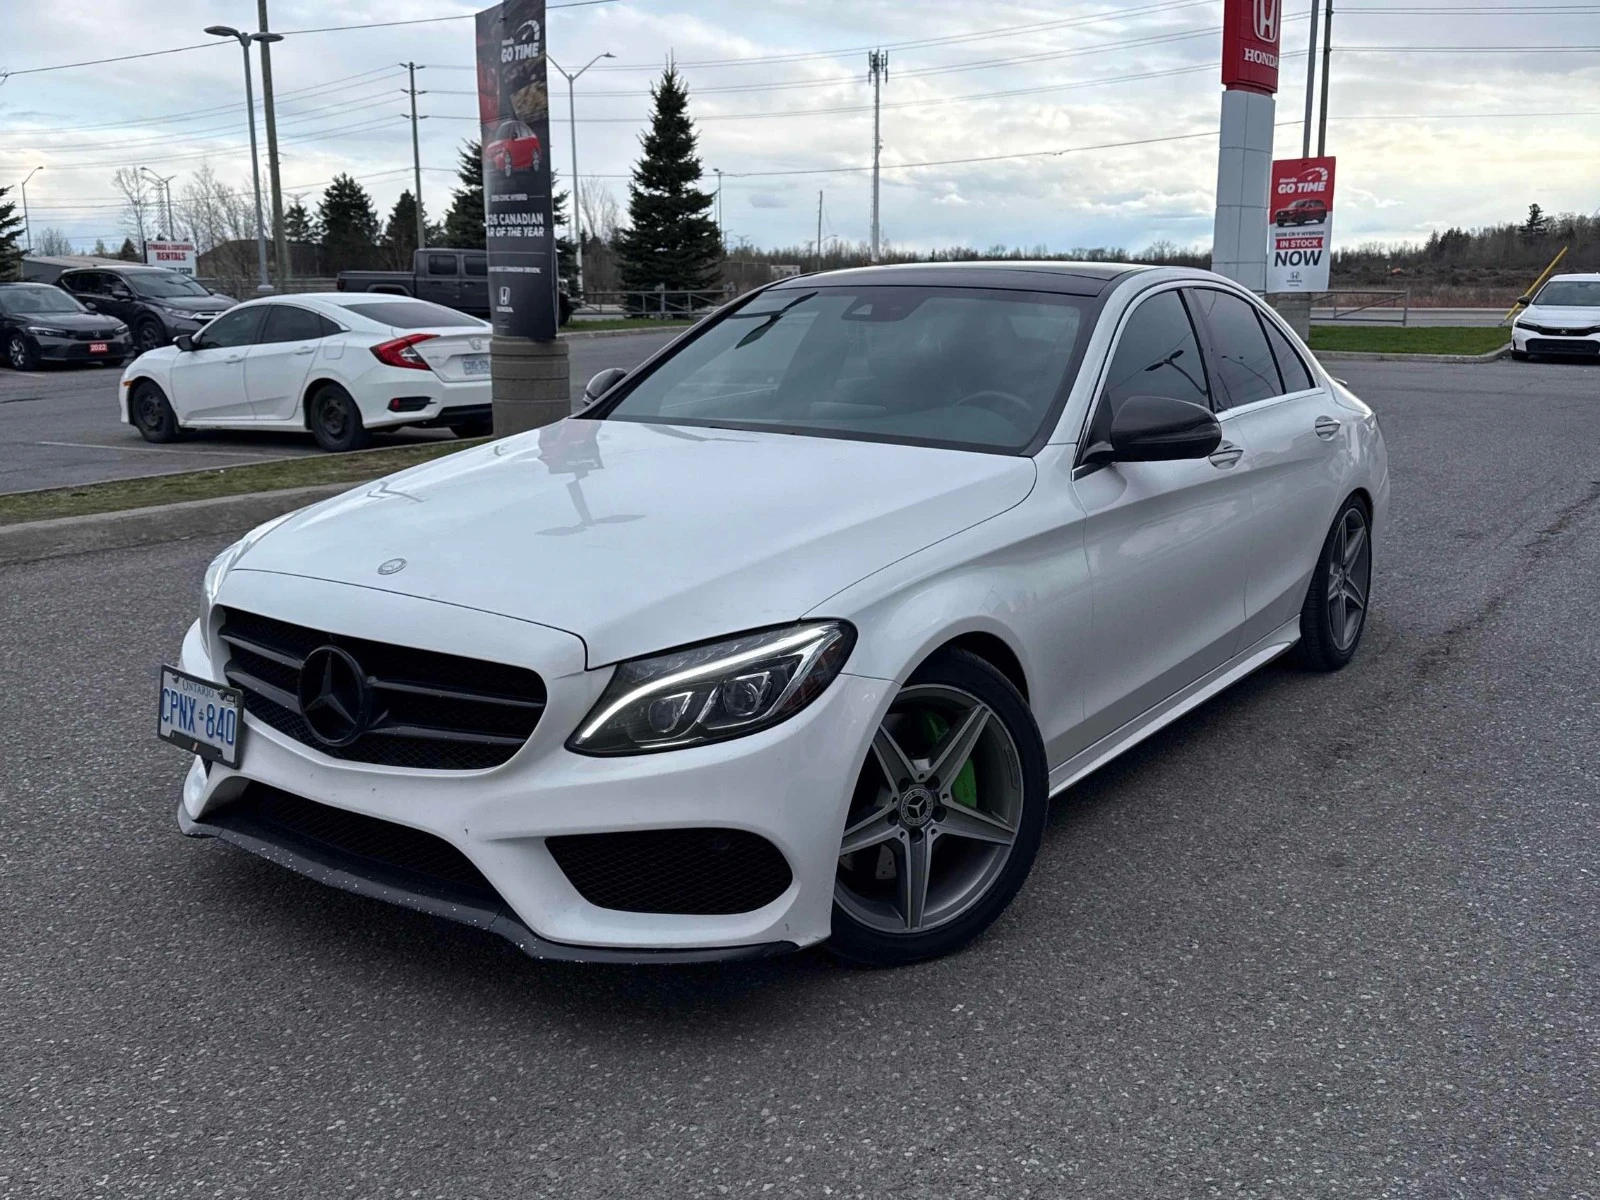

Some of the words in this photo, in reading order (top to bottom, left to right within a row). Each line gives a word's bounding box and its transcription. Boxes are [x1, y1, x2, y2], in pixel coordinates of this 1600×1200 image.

[501, 47, 513, 63] GO
[514, 42, 539, 60] TIME
[1277, 183, 1296, 194] GO
[1297, 181, 1327, 193] TIME
[499, 212, 544, 225] CANADIAN
[495, 226, 506, 237] OF
[507, 226, 522, 237] THE
[522, 226, 545, 237] YEAR
[1280, 240, 1289, 248] IN
[1290, 239, 1319, 248] STOCK
[156, 252, 186, 261] RENTALS
[1274, 249, 1323, 267] NOW
[90, 343, 108, 352] 2022
[182, 679, 215, 697] ONTARIO
[161, 688, 197, 733] CPNX
[206, 703, 236, 746] 840
